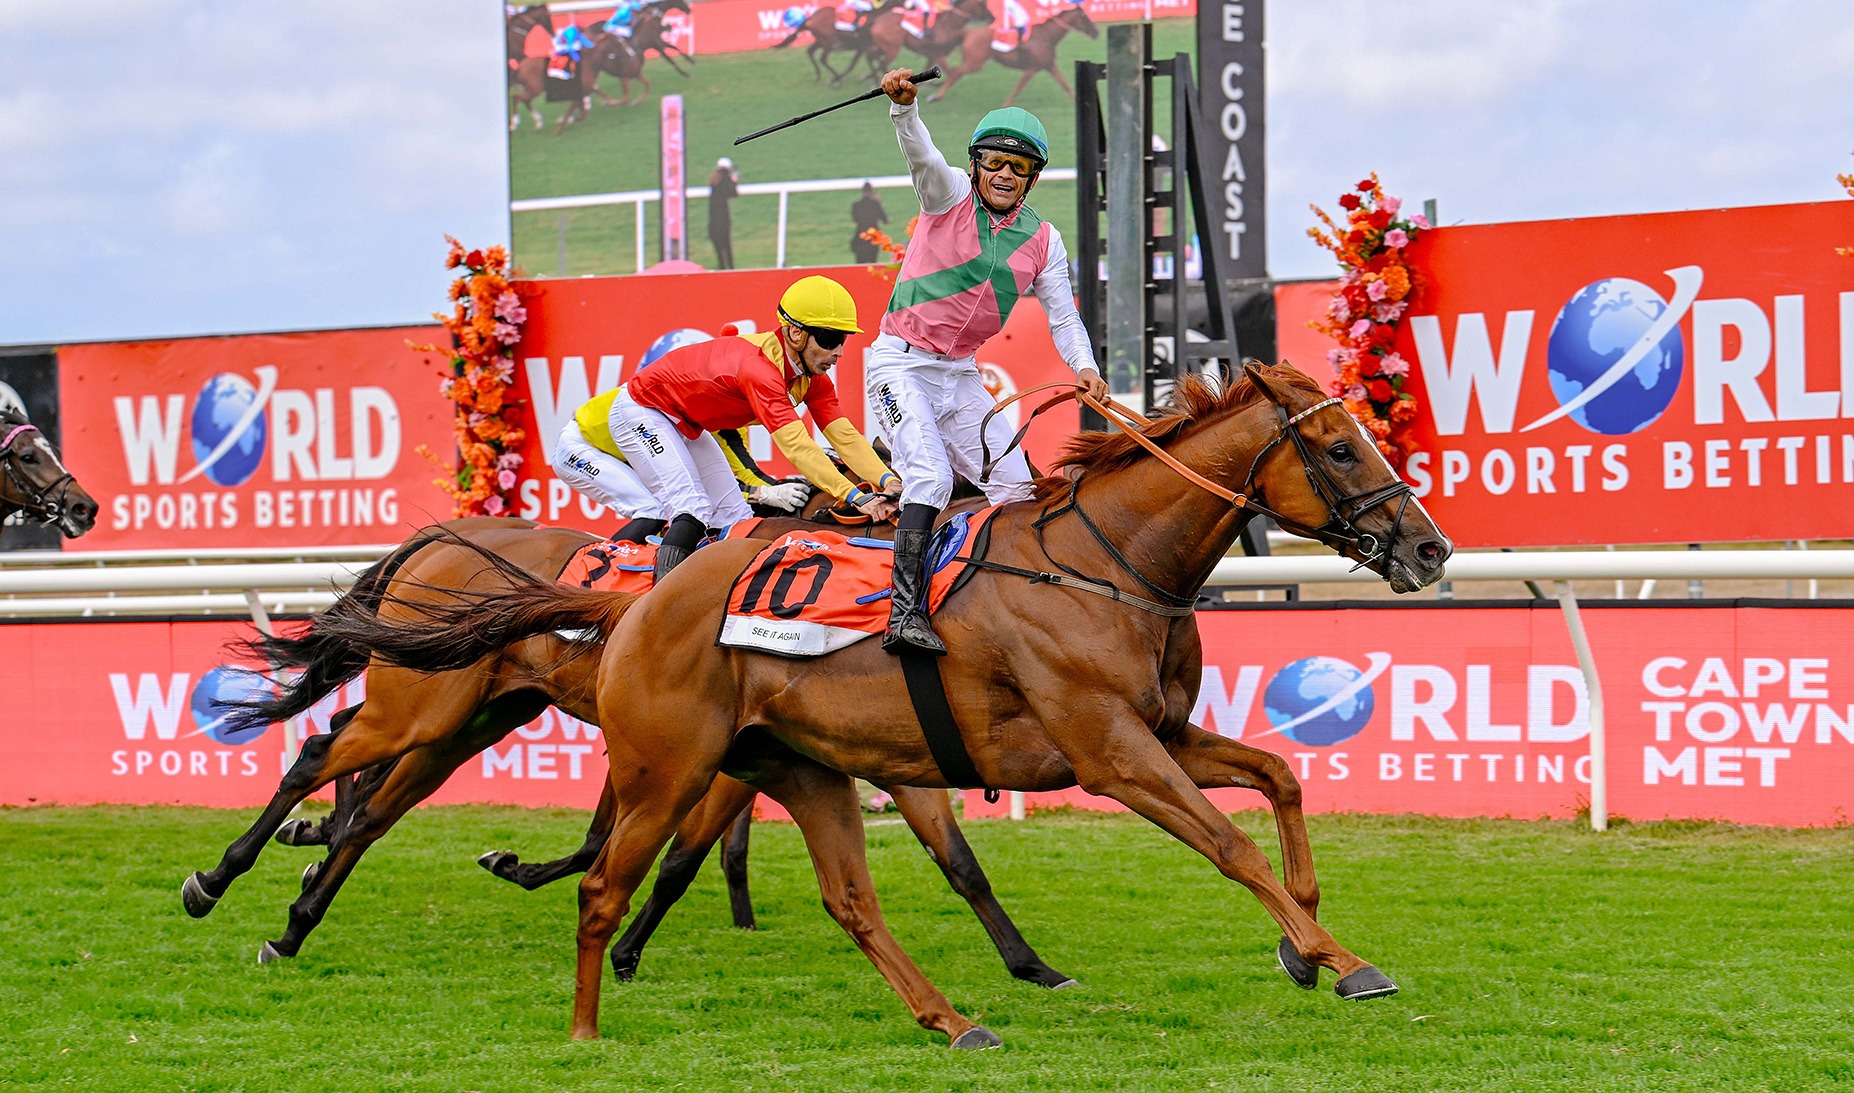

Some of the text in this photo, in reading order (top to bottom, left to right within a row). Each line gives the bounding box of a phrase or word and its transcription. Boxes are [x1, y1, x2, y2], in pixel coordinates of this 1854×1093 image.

[1220, 62, 1247, 259] COAST
[1410, 265, 1854, 436] WORL
[114, 365, 400, 487] WORLD
[637, 423, 664, 454] WORLD
[568, 453, 600, 476] WORLD
[1406, 444, 1629, 498] SPORTS
[112, 488, 398, 531] SPORTS BETTING
[739, 546, 833, 619] 10
[752, 626, 801, 641] SEE IT AGAIN
[1188, 652, 1593, 746] WORLD
[1642, 656, 1829, 699] CAPE
[1641, 701, 1854, 744] TOWN
[111, 750, 258, 776] SPORTS
[482, 743, 594, 780] MET
[1643, 746, 1791, 787] MET
